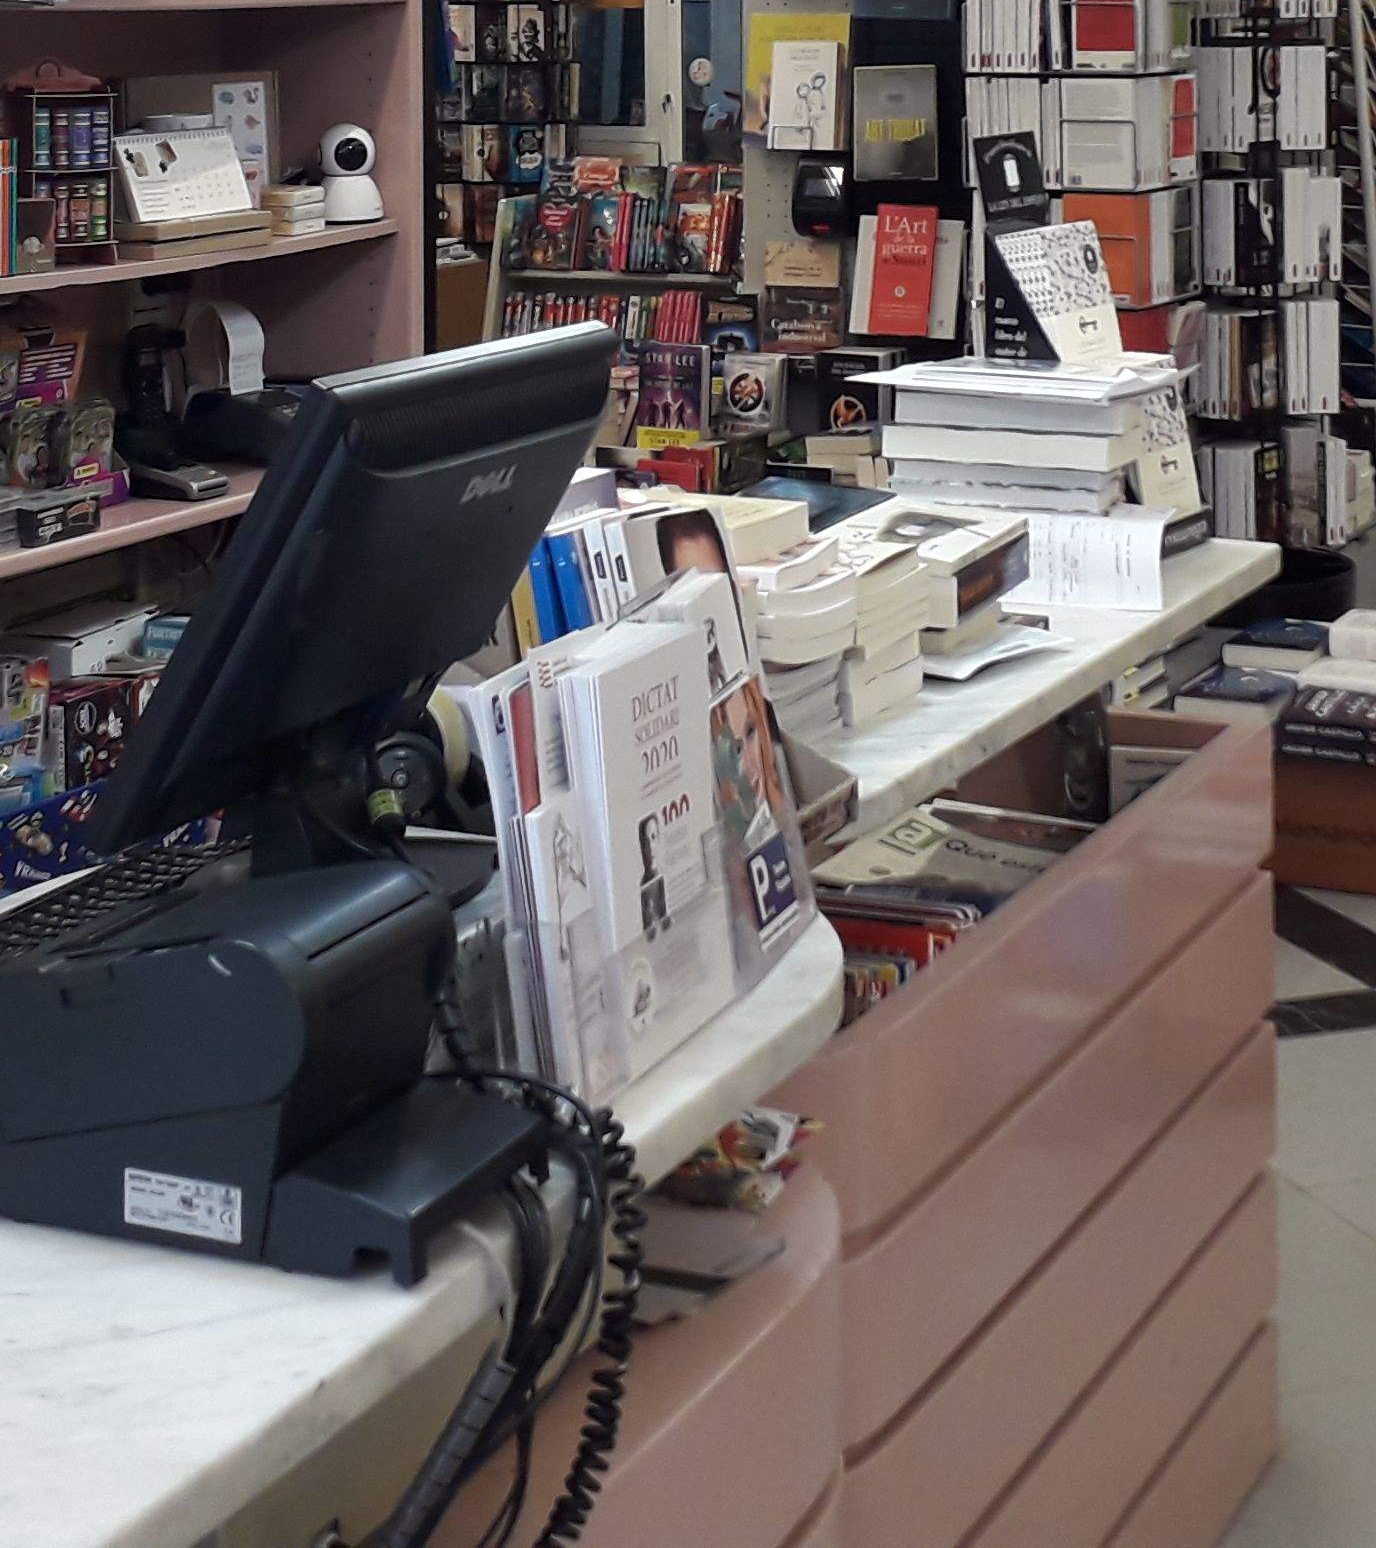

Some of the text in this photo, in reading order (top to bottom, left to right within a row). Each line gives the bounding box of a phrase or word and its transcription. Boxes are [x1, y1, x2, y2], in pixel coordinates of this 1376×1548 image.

[884, 215, 928, 235] L'Art
[881, 243, 928, 258] guerra
[631, 675, 680, 723] DICTAT
